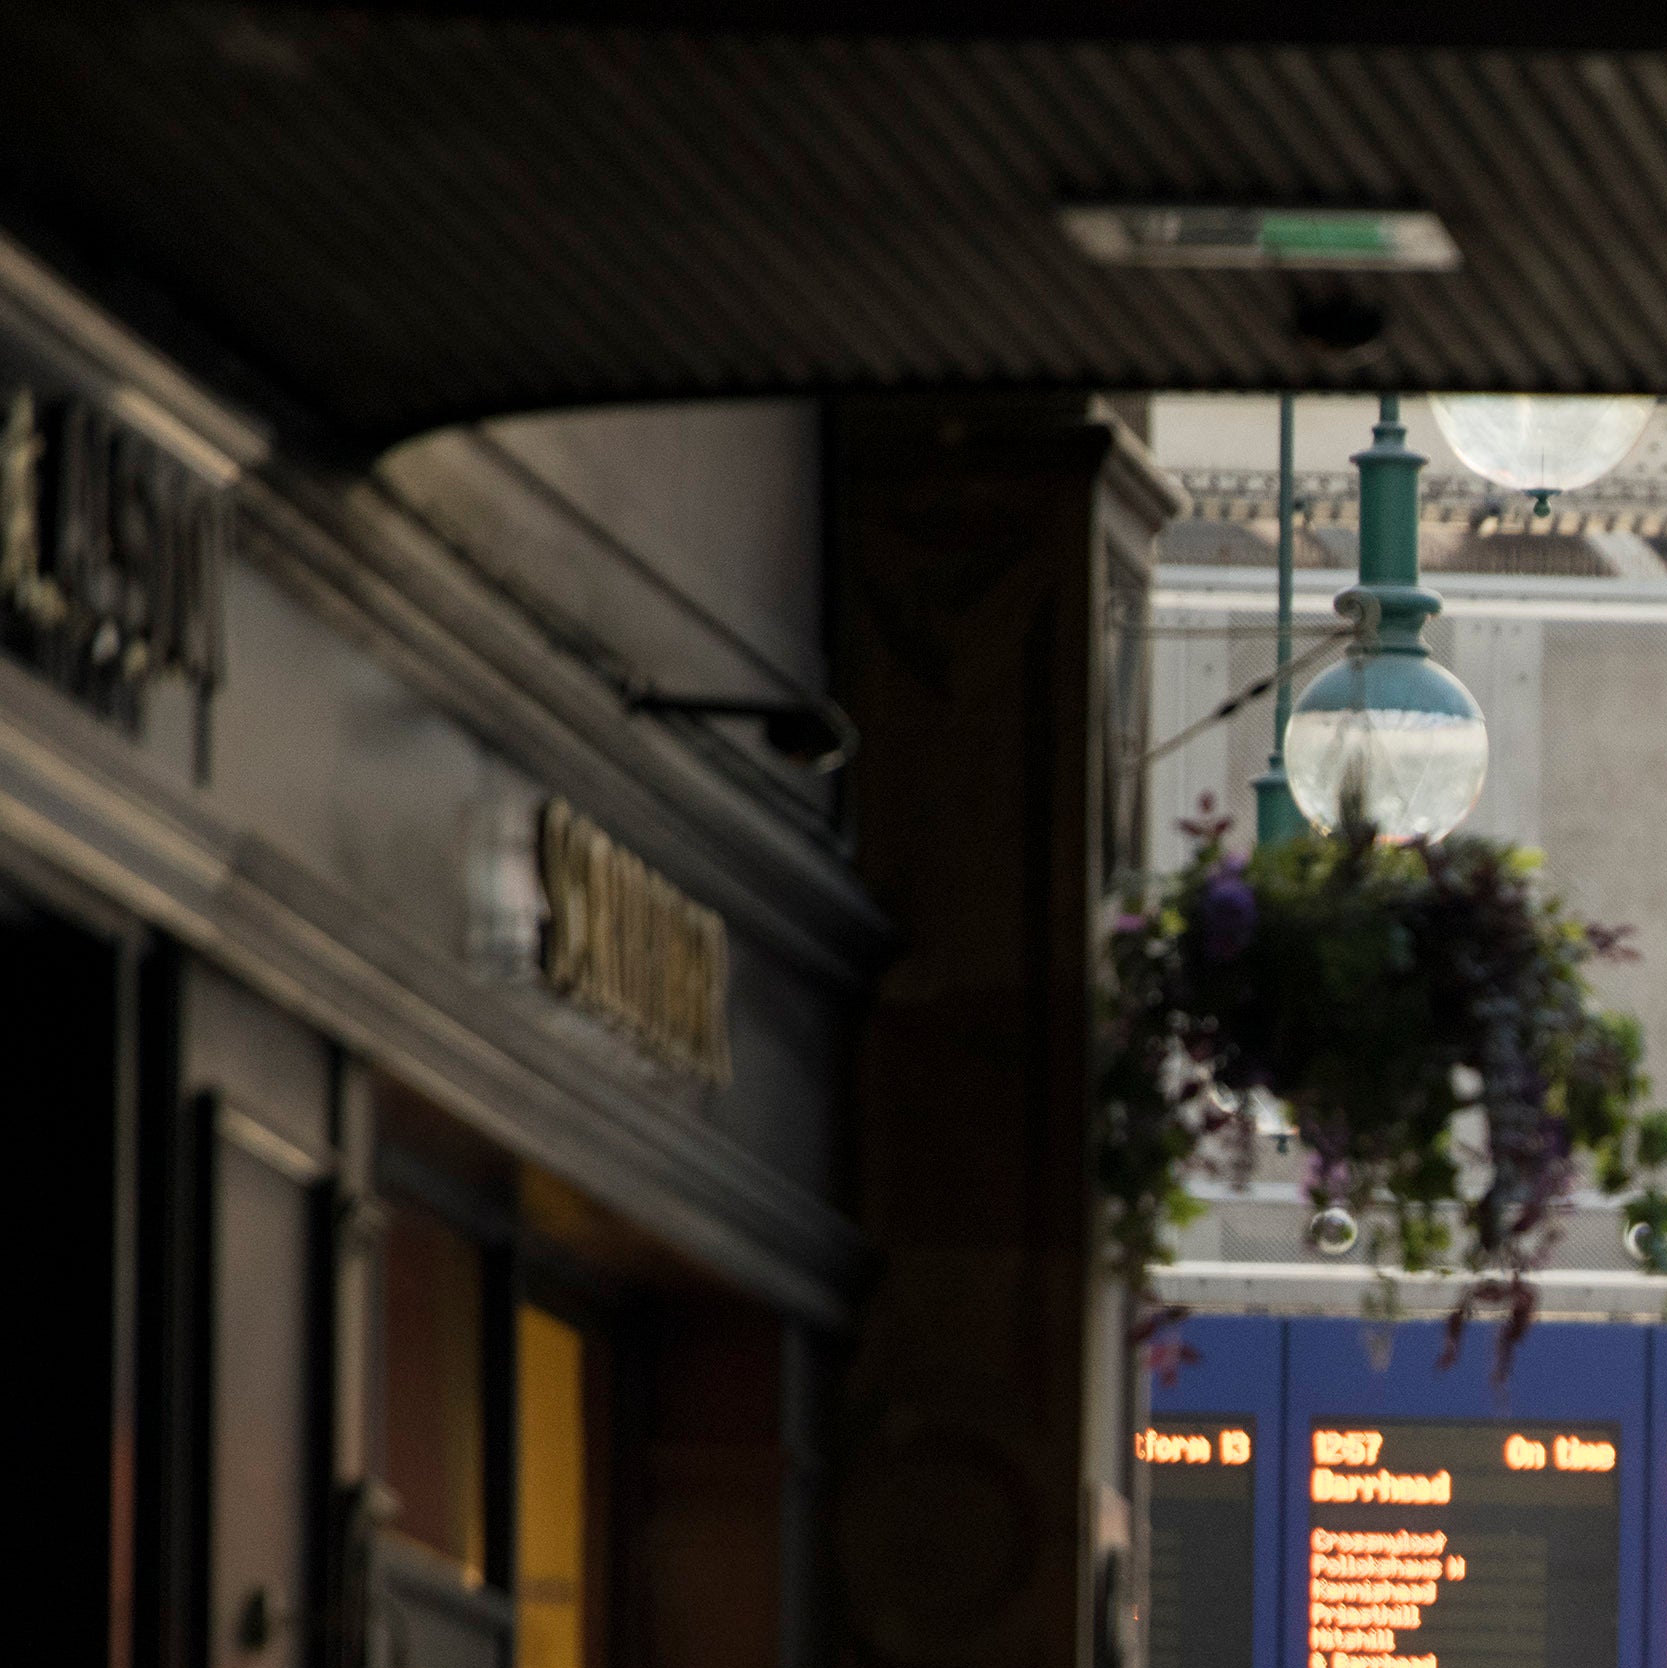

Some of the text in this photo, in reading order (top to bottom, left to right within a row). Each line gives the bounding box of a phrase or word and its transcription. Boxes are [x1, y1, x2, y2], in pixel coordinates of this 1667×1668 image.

[1506, 1435, 1546, 1470] On
[1555, 1436, 1616, 1470] time
[1312, 1468, 1451, 1503] Barrhead
